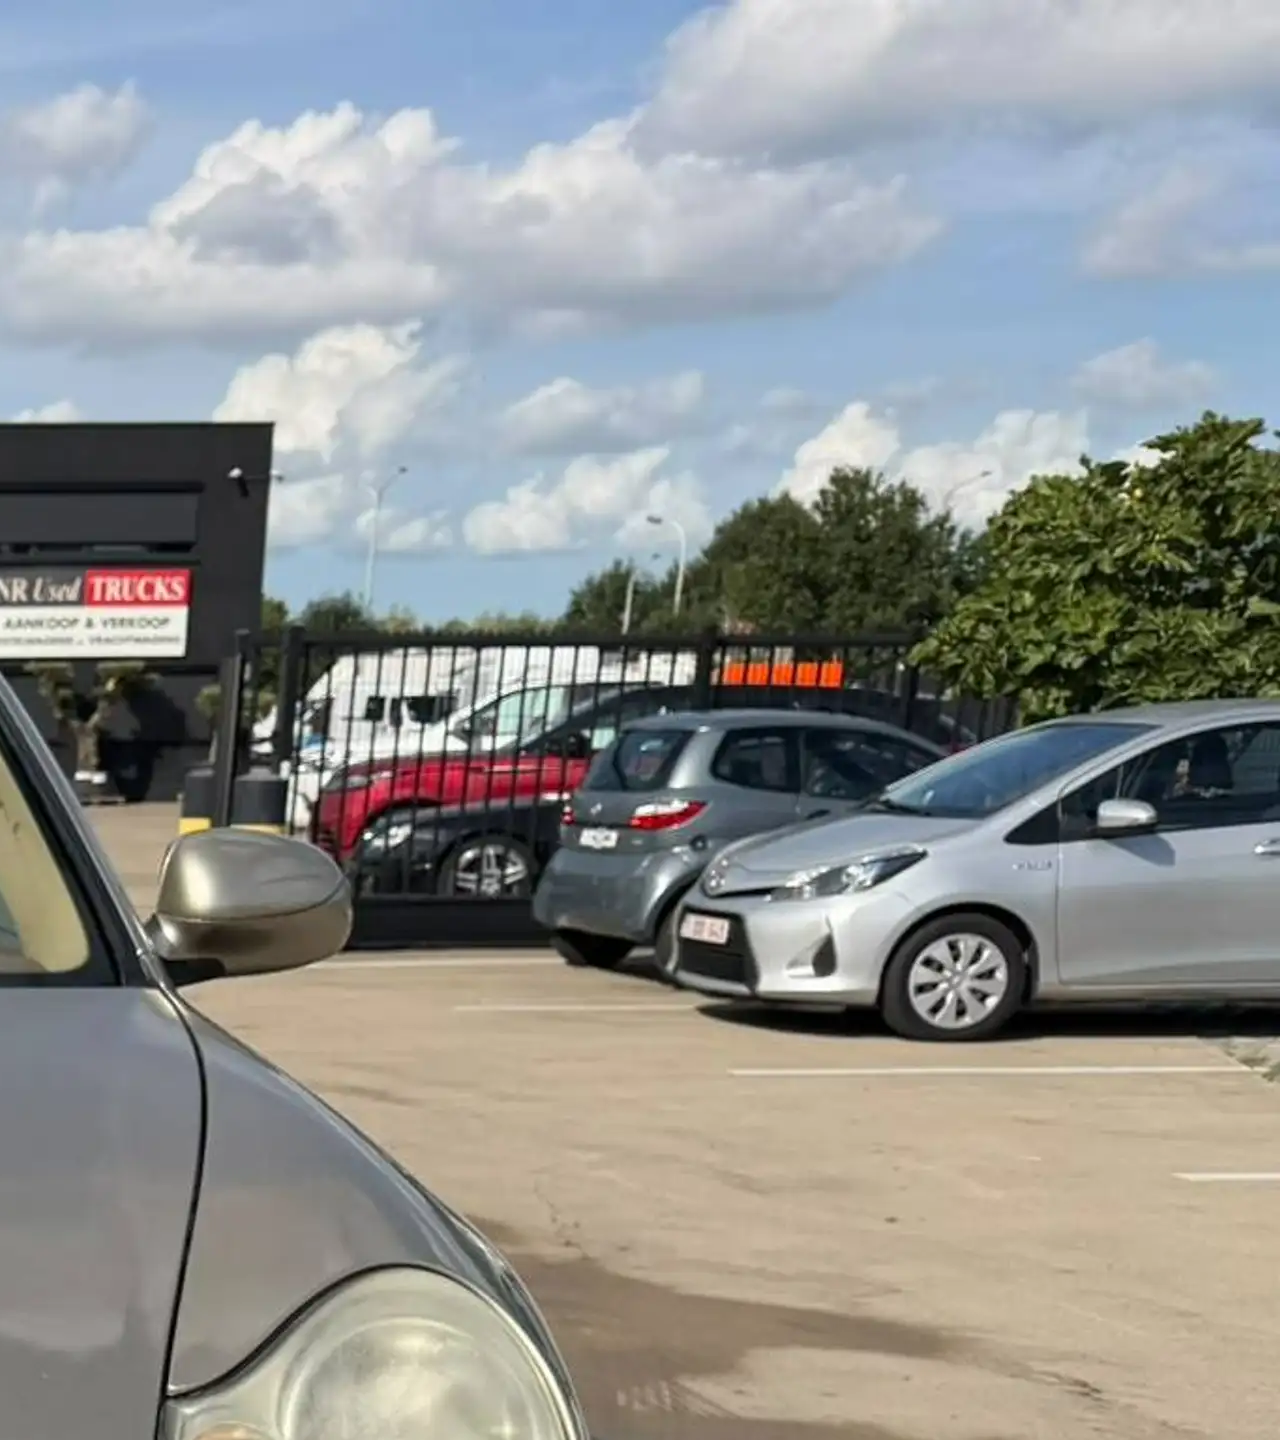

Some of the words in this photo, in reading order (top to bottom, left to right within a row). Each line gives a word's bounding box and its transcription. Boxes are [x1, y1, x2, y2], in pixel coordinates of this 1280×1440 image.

[32, 576, 82, 602] Used
[90, 575, 186, 602] TRUCKS
[3, 616, 80, 629] AANKOOP
[100, 616, 170, 629] VERKOOP
